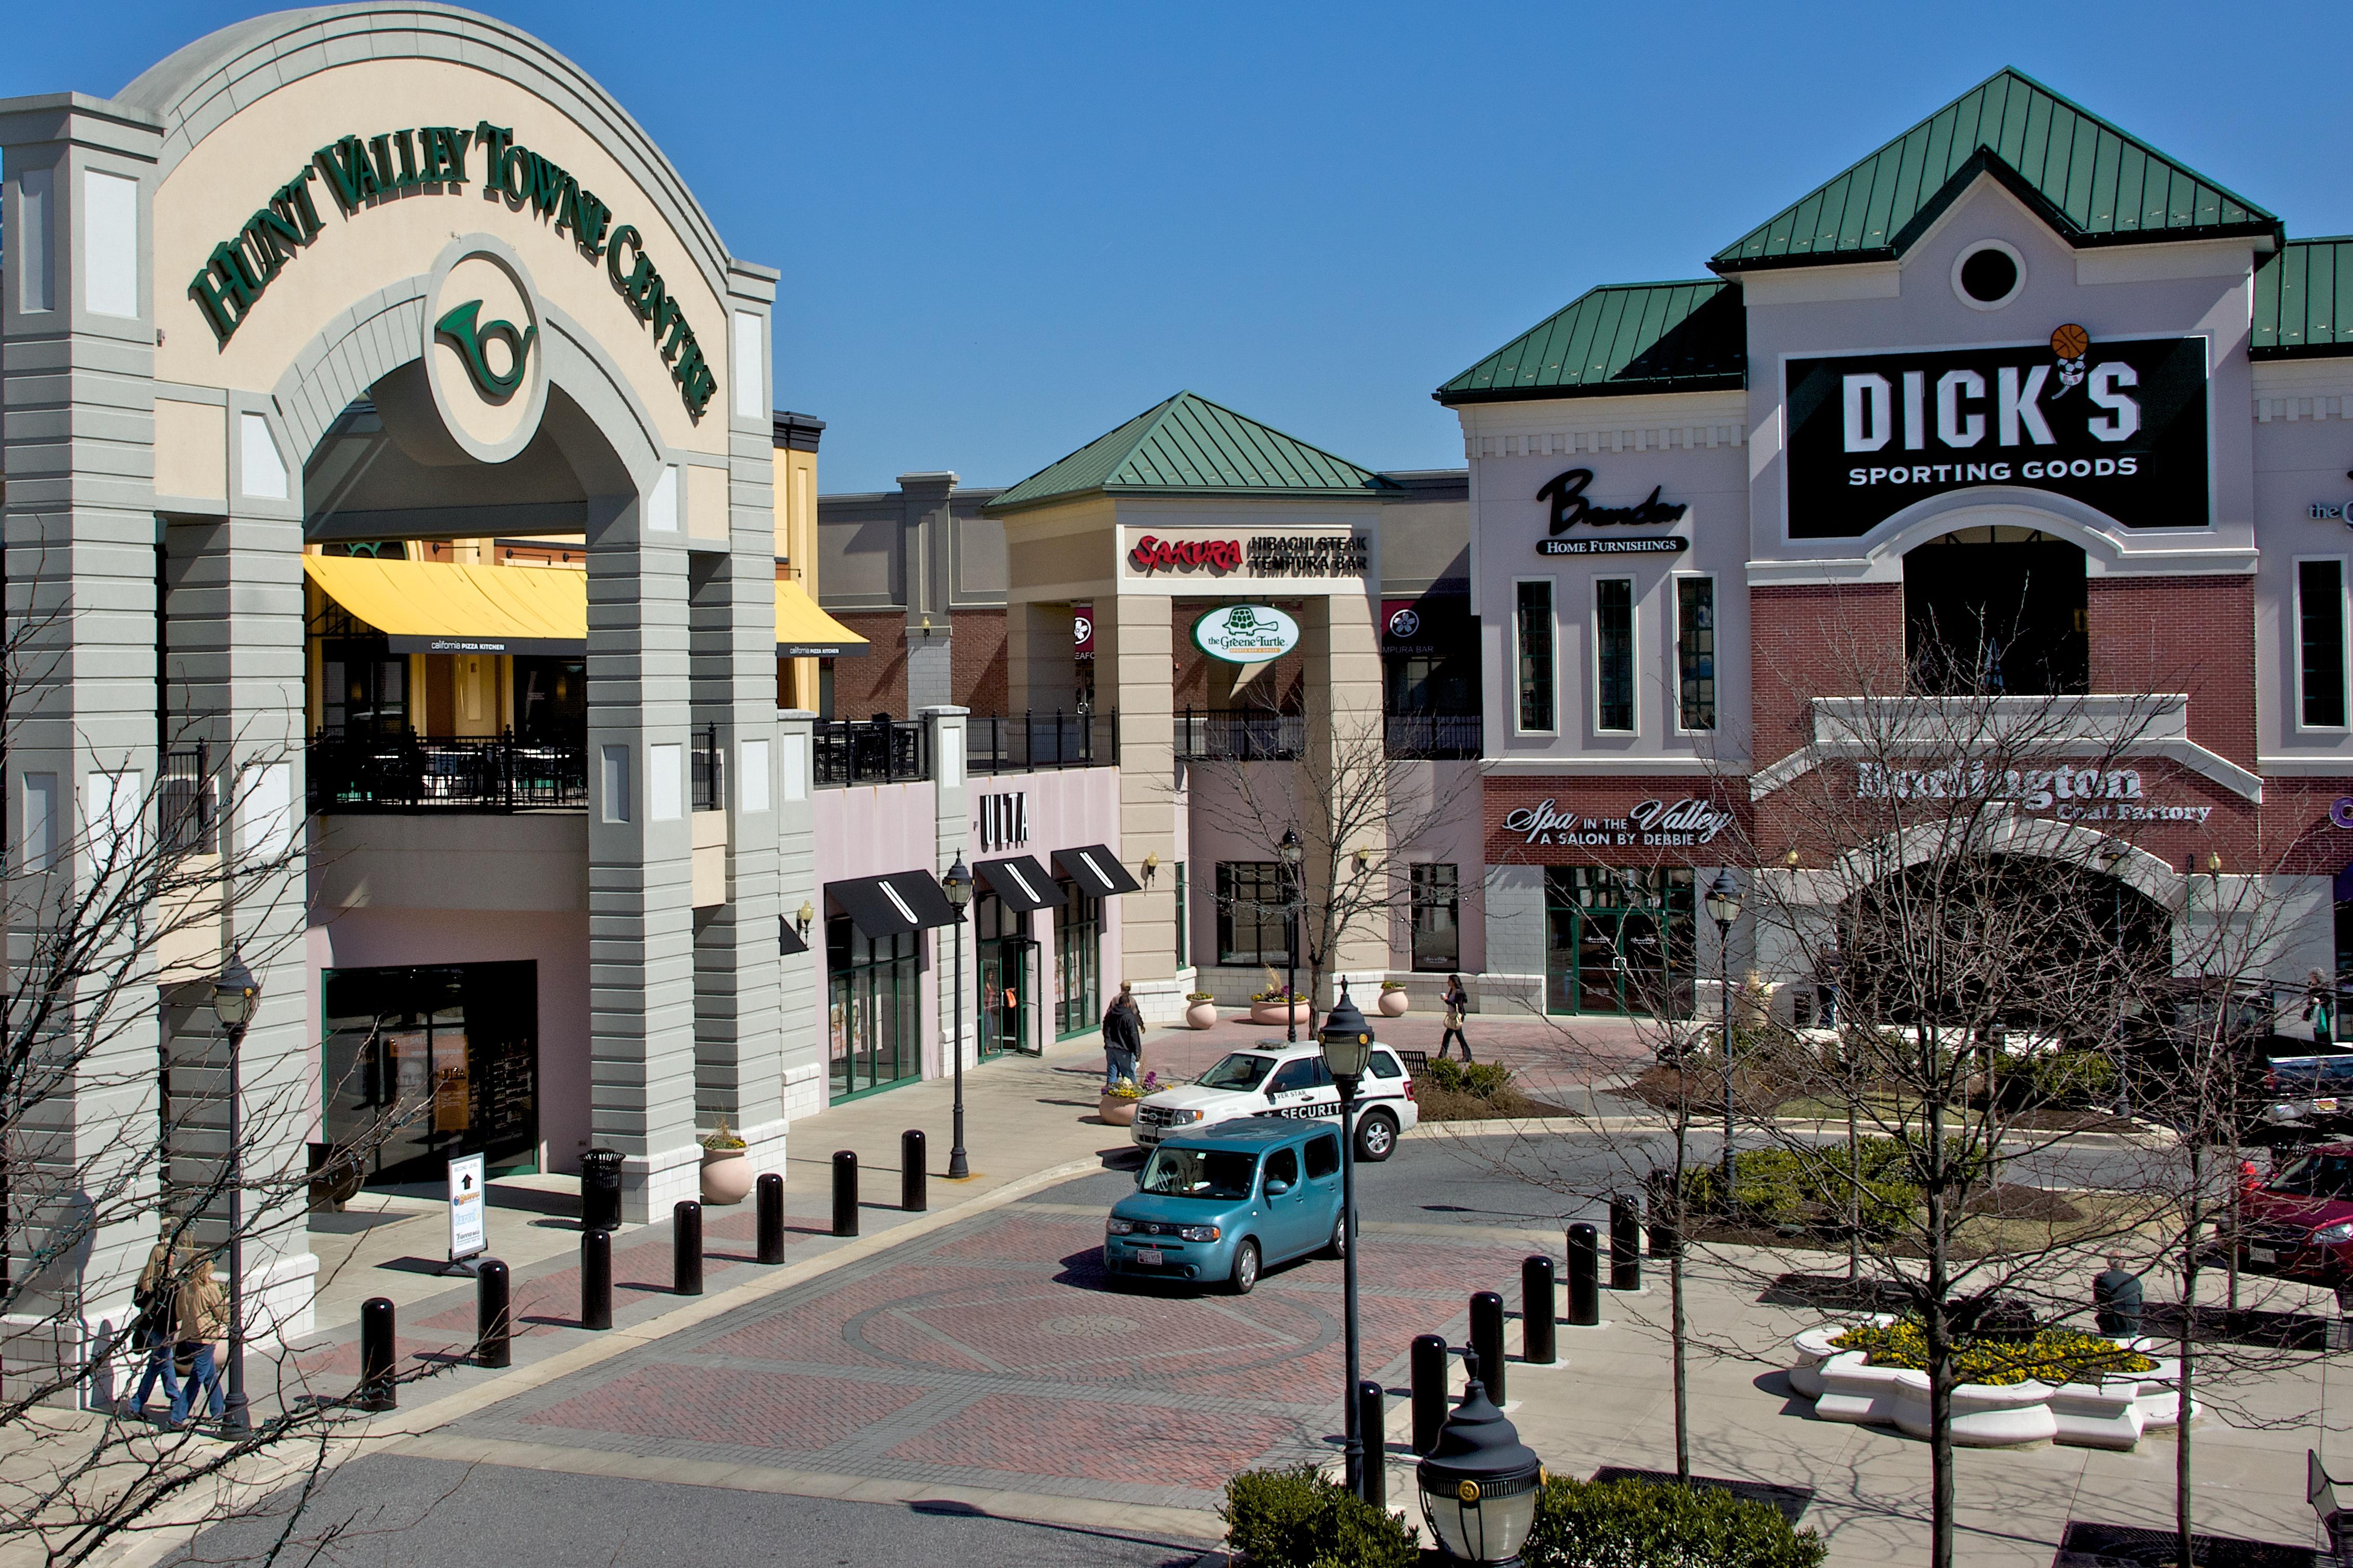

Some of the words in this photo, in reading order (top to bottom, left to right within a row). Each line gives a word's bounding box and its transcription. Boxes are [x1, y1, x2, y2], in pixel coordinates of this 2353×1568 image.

[1843, 358, 2141, 453] DICK'S
[1848, 462, 2011, 485] SPORTING
[2022, 457, 2138, 479] GOODS
[1132, 535, 1243, 570] SAKURA
[1251, 537, 1314, 551] HIBACHI
[1317, 537, 1367, 551] STEAK
[1546, 541, 1587, 553] HOME
[1590, 540, 1676, 552] FURNISHINGS
[1251, 556, 1329, 570] TEMPURA
[1333, 556, 1368, 570] BAR
[431, 639, 460, 649] california
[1221, 636, 1255, 649] Greene
[1256, 636, 1285, 646] Turtle
[984, 792, 1029, 846] ULTA
[1502, 799, 1578, 843] Spa
[1584, 818, 1597, 830] IN
[1604, 818, 1628, 830] THE
[1630, 799, 1734, 844] Valley
[2117, 804, 2212, 823] Factory
[1540, 833, 1552, 845] A
[1558, 833, 1610, 845] SALON
[1617, 833, 1635, 845] BY
[1644, 834, 1695, 846] DEBBIE
[1281, 1102, 1341, 1119] SECURIT
